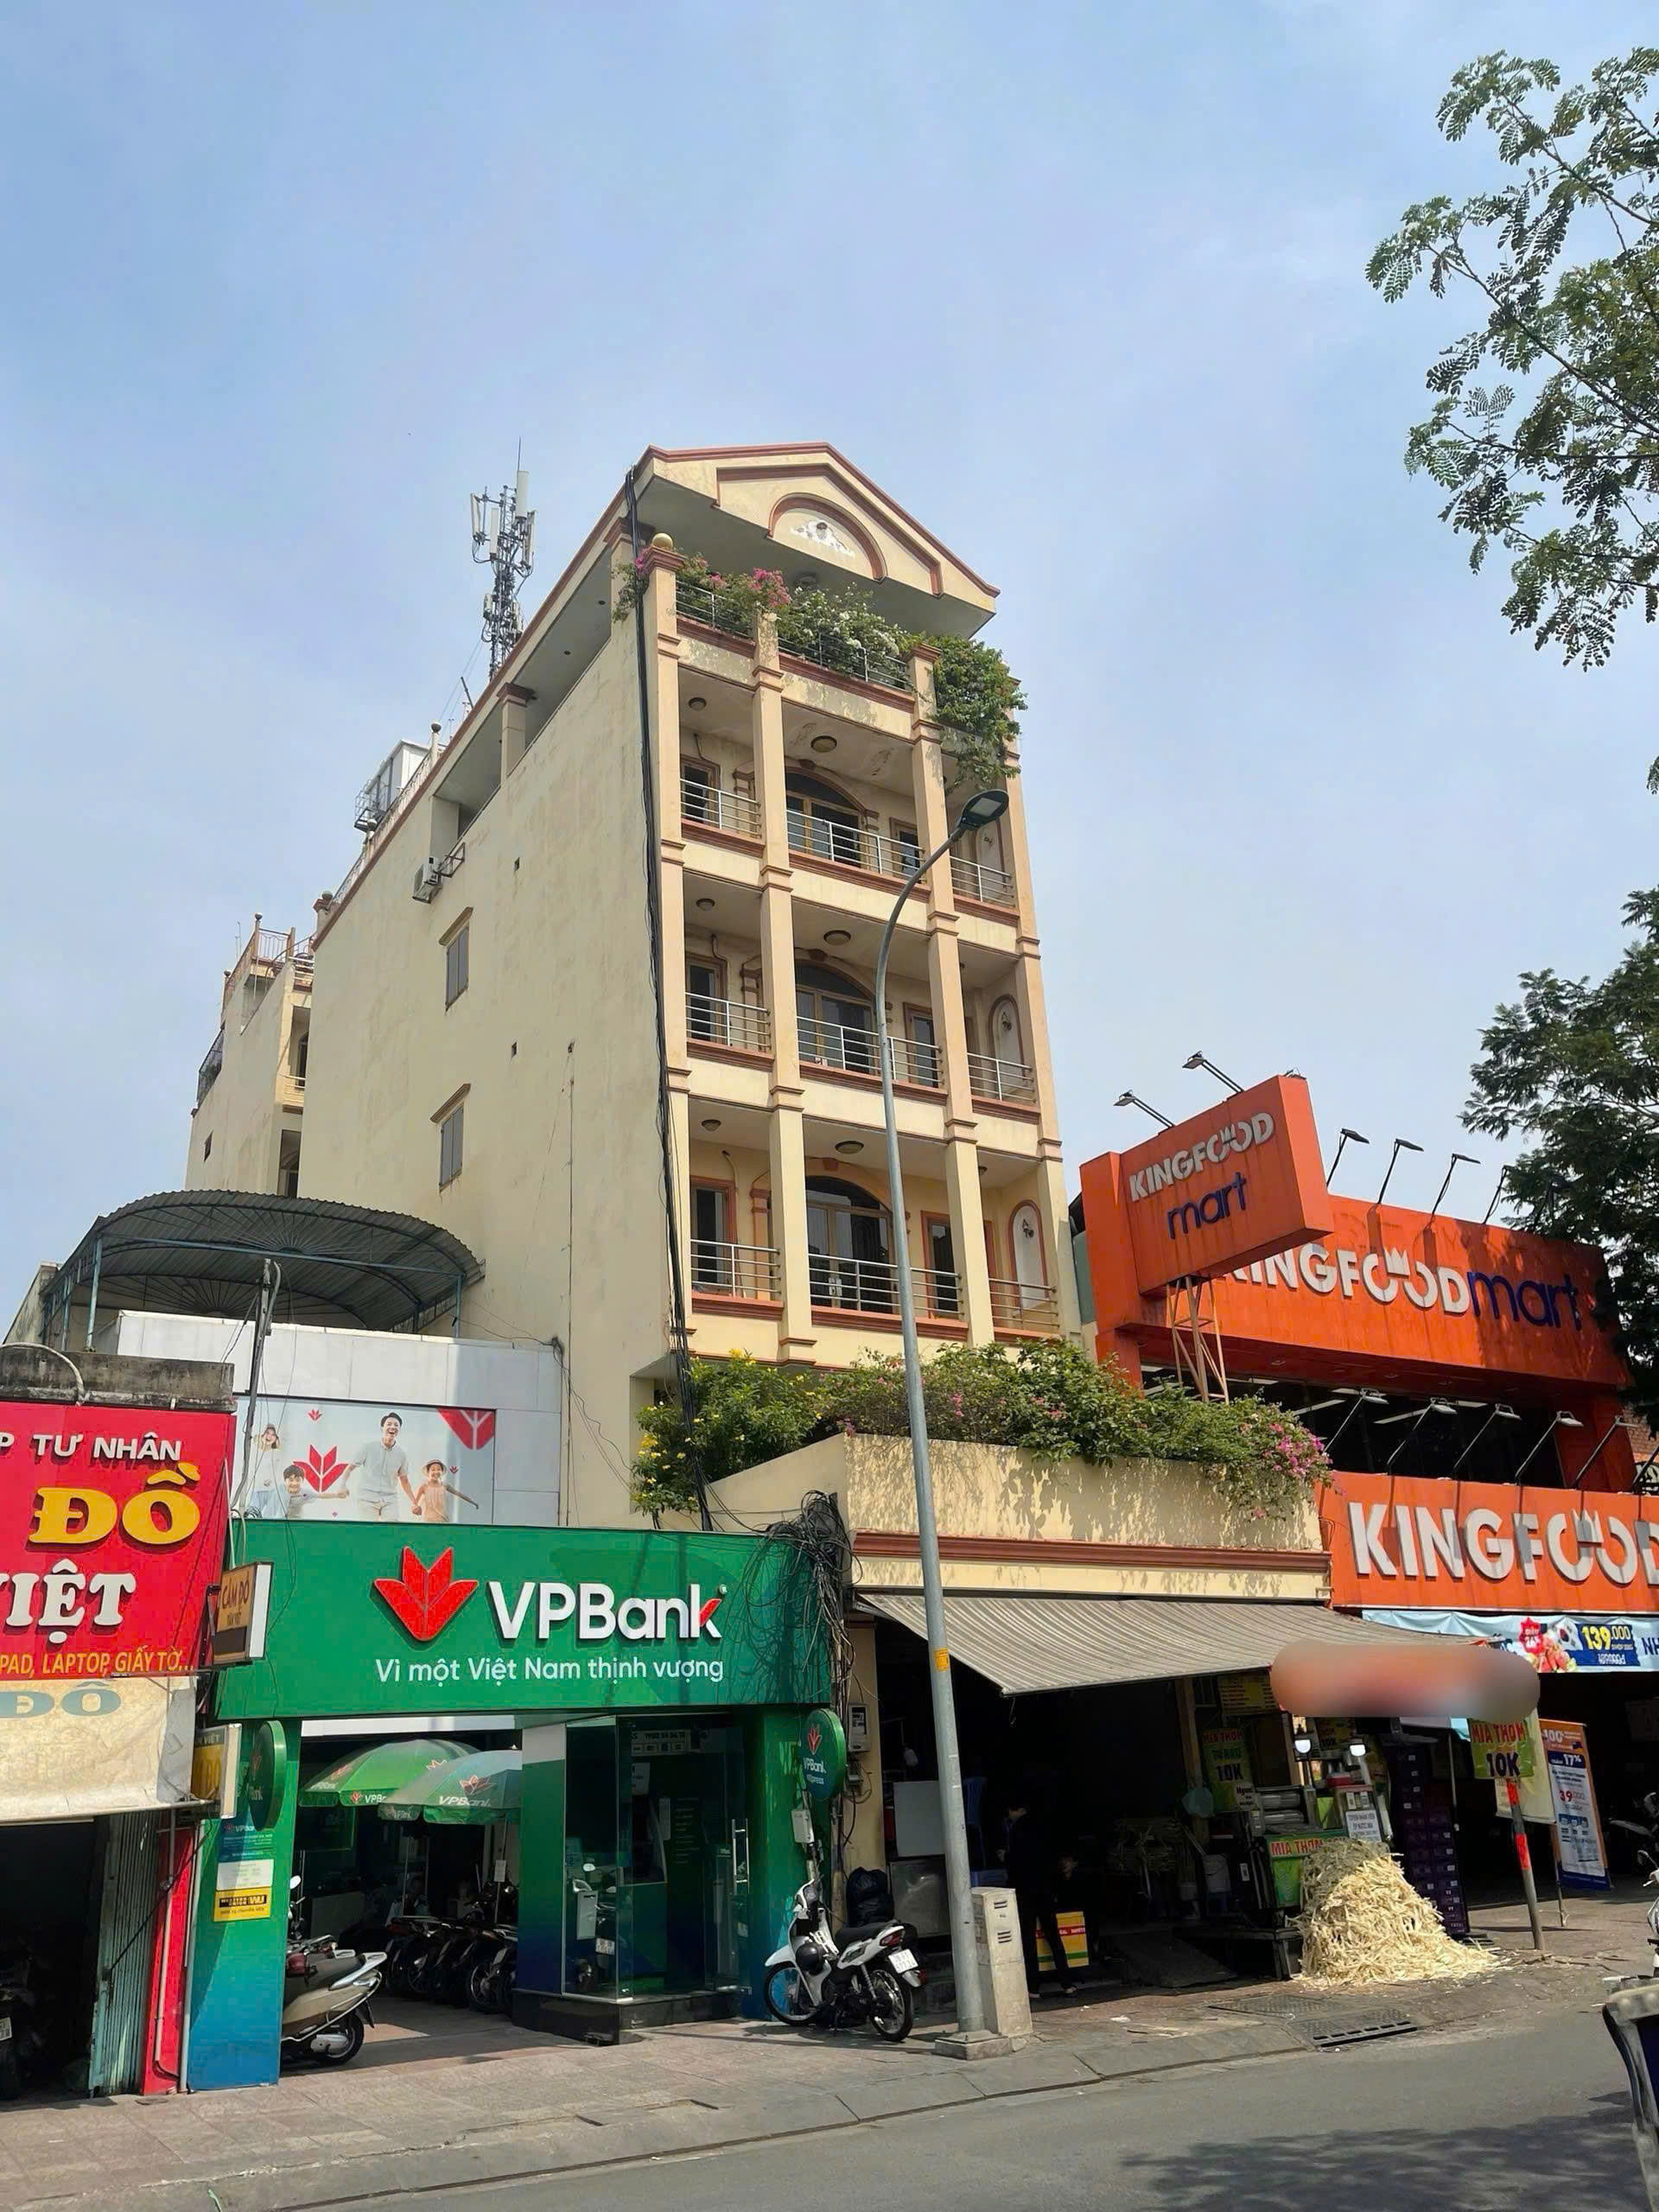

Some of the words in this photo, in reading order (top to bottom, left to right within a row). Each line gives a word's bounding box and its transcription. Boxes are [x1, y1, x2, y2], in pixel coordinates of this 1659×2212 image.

[1129, 1112, 1274, 1202] KINGFOOD
[1167, 1171, 1246, 1239] mart
[1222, 1243, 1469, 1314] INGFOOD
[1467, 1271, 1581, 1332] mart
[33, 1433, 84, 1457] TƯ
[92, 1431, 181, 1461] NHÂN
[0, 1558, 137, 1643] IỆT
[487, 1580, 722, 1640] VPBank
[42, 1652, 109, 1677] LAPTOP,
[115, 1644, 155, 1673] GIẤY
[375, 1657, 400, 1682] Vì
[408, 1657, 460, 1687] một
[467, 1657, 517, 1686] Việt
[524, 1658, 581, 1680] Nam
[588, 1657, 646, 1685] thịnh
[652, 1657, 724, 1684] vượng
[1486, 1751, 1521, 1777] 10K
